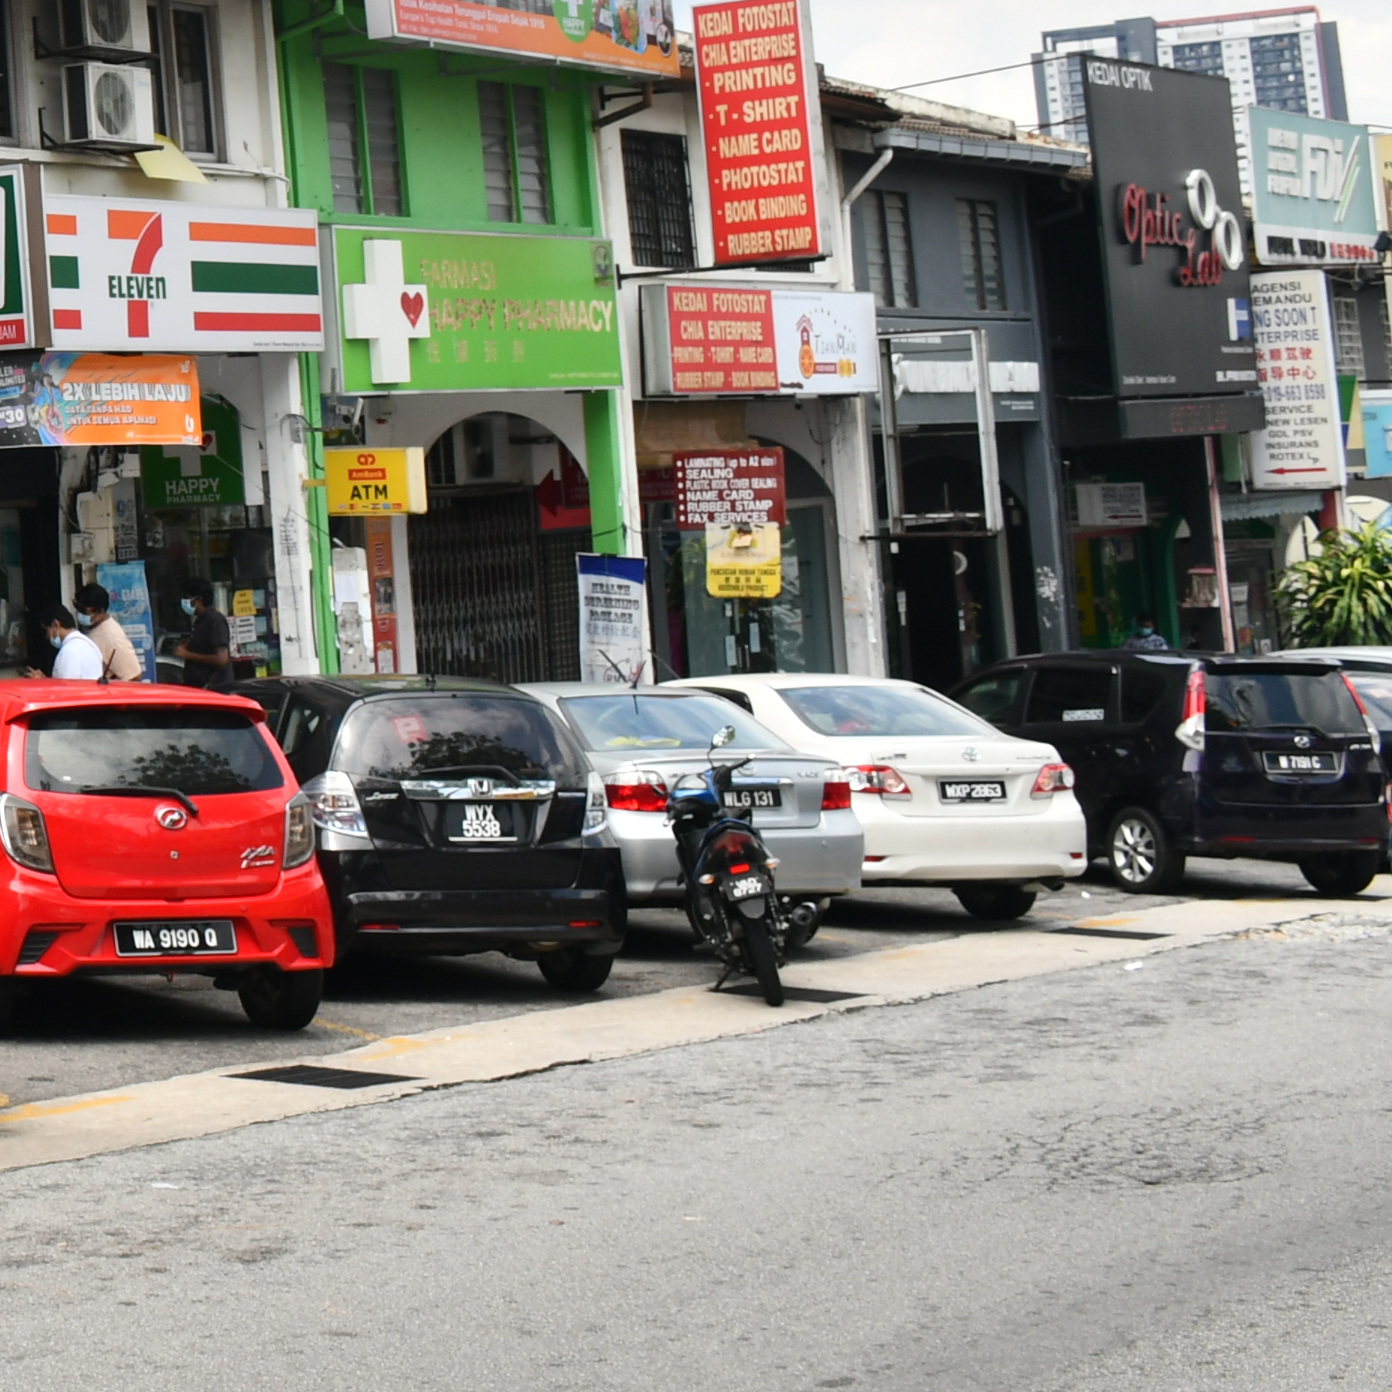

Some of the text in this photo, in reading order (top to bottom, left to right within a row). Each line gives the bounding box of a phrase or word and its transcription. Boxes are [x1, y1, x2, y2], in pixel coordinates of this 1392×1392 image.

[698, 1, 795, 38] KEDAI FOTOSTAT
[702, 33, 796, 68] CHIA ENTERPRISE
[713, 63, 796, 94] PRINTING
[1086, 61, 1153, 92] KEDAI OPTIK
[716, 95, 799, 126] T SHIRT
[719, 128, 801, 159] NAME CARD
[722, 161, 805, 191] PHOTOSTAT
[724, 194, 807, 224] BOOK BINDING
[1123, 183, 1182, 264] Optic
[727, 227, 813, 256] RUBBER STAMP
[421, 259, 496, 290] FARMASI
[1252, 281, 1301, 294] AGENSI
[673, 292, 766, 313] KEDAI FOTOSTAT
[429, 298, 613, 332] HAPPY PHARMACY
[1276, 308, 1307, 326] SOON
[680, 320, 763, 341] CHIA ENTERPRISE
[64, 383, 191, 402] 2X LEBIH LAJU
[1265, 405, 1314, 415] SERVICE
[1294, 417, 1328, 425] LESEN
[1293, 429, 1313, 437] PSV
[1266, 441, 1319, 450] INSURANS
[685, 458, 724, 468] LAMINATING
[749, 456, 759, 467] A2
[1269, 452, 1304, 461] ROTEX
[686, 468, 733, 479] SEALING
[165, 478, 220, 497] HAPPY
[350, 484, 388, 500] ATM
[687, 490, 754, 501] NAME CARD
[166, 493, 221, 504] PHARMACY
[687, 500, 773, 512] RUBBER STAMP
[688, 512, 767, 523] FAX SERVICES
[724, 791, 774, 807] WLG 131
[945, 784, 970, 798] WXP
[465, 805, 494, 822] WYX
[462, 821, 501, 838] 5538
[132, 930, 155, 949] WA
[159, 928, 200, 948] 9190
